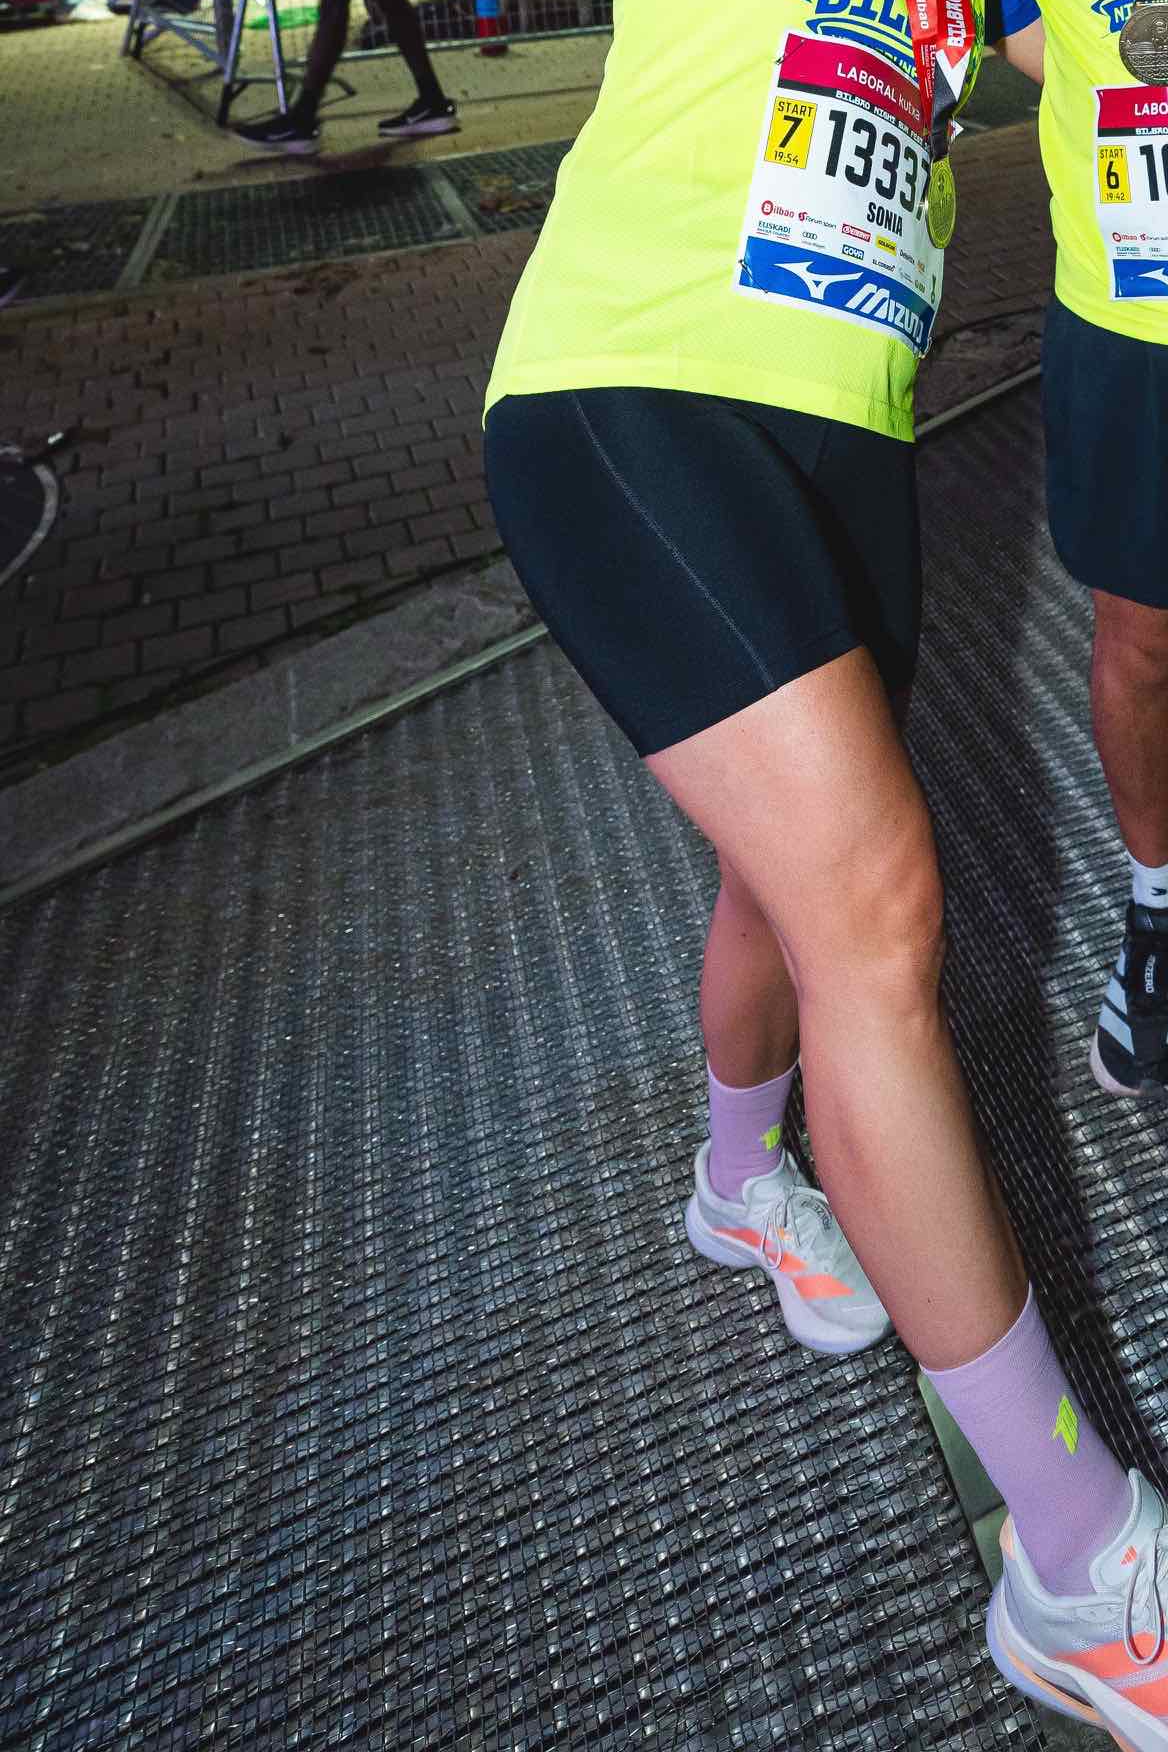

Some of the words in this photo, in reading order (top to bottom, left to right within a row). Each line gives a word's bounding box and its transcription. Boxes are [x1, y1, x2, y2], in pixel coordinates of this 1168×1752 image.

[837, 63, 897, 102] LABORAL
[898, 94, 921, 121] kutxa
[777, 101, 813, 118] START
[779, 114, 803, 149] 7
[774, 150, 799, 165] 19:54
[1100, 149, 1124, 160] START
[1106, 161, 1120, 190] 6
[1106, 192, 1125, 201] 19:42
[761, 200, 795, 219] Bilbao
[758, 220, 791, 234] EUSKADI
[867, 202, 903, 237] SONIA
